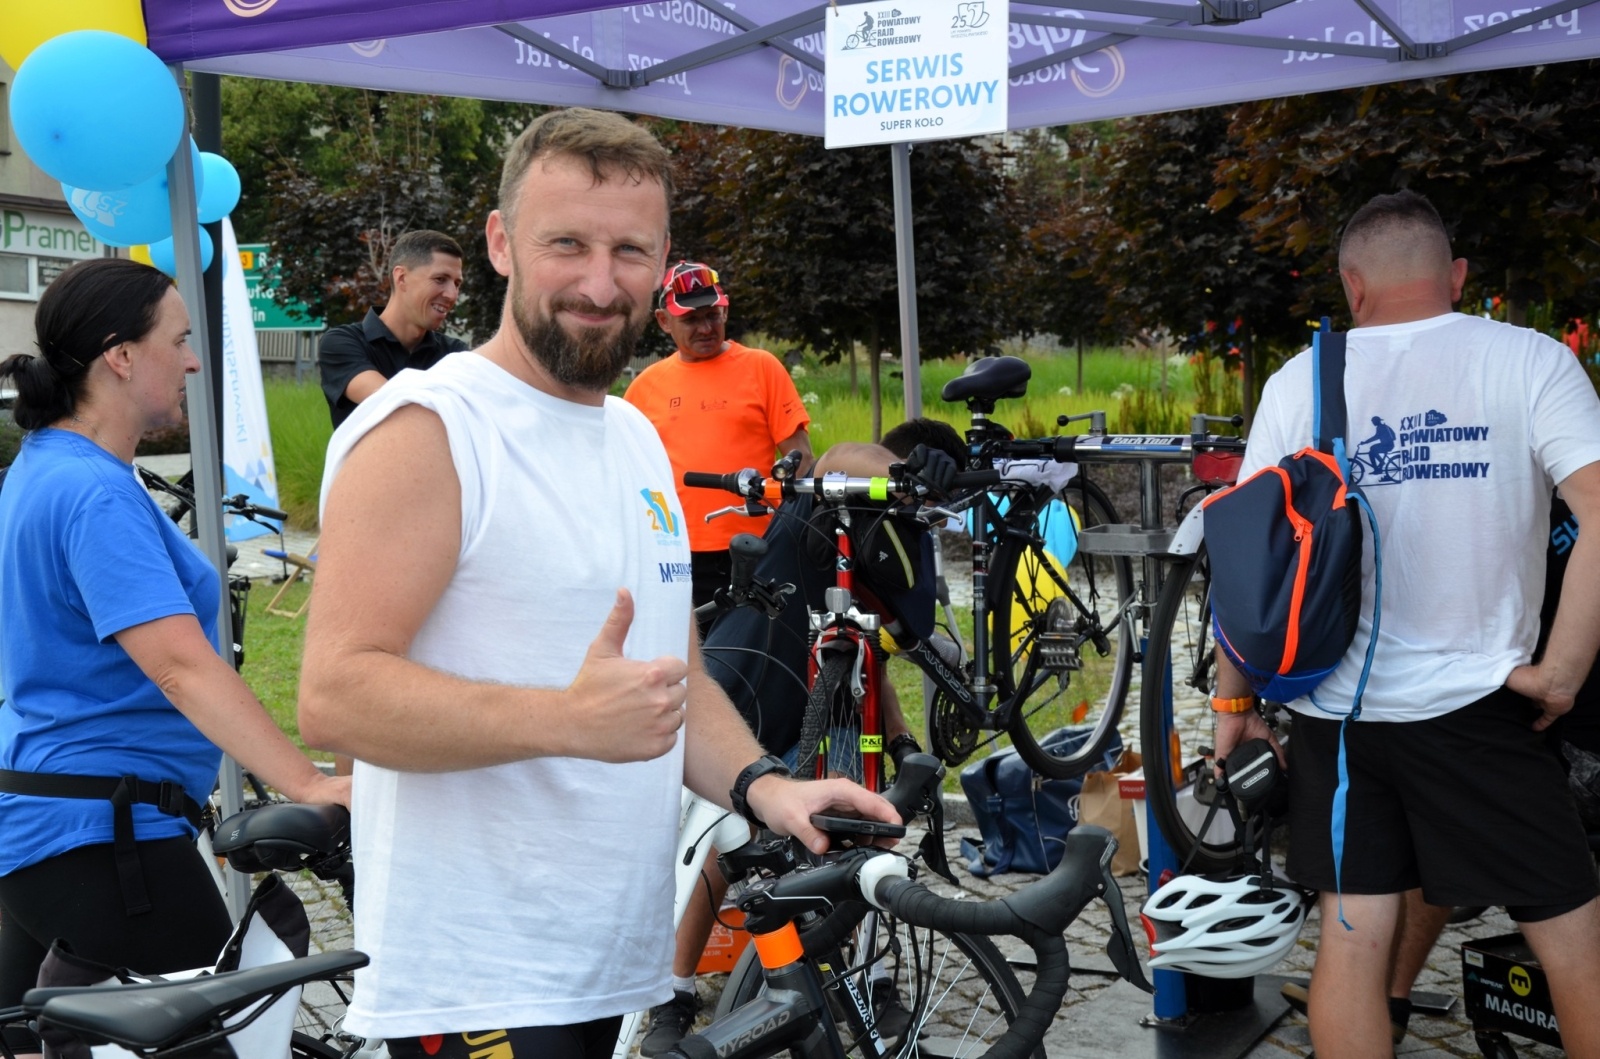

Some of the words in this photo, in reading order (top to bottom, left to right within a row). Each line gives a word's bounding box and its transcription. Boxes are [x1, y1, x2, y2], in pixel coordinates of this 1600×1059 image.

[877, 16, 921, 27] POWIATOWY
[951, 15, 967, 28] 25
[877, 28, 894, 37] RAJD
[877, 34, 922, 47] ROWEROWY
[866, 52, 963, 84] SERWIS
[833, 80, 998, 118] ROWEROWY
[880, 119, 912, 131] SUPER
[914, 116, 944, 129] KOŁO
[1110, 437, 1143, 445] Park
[1143, 437, 1175, 446] Tool
[1400, 426, 1489, 447] POWIATOWY
[1402, 446, 1430, 465] RJD
[1402, 462, 1490, 482] ROWEROWY
[1485, 993, 1560, 1033] MAGURA
[715, 1010, 790, 1058] VYROAD
